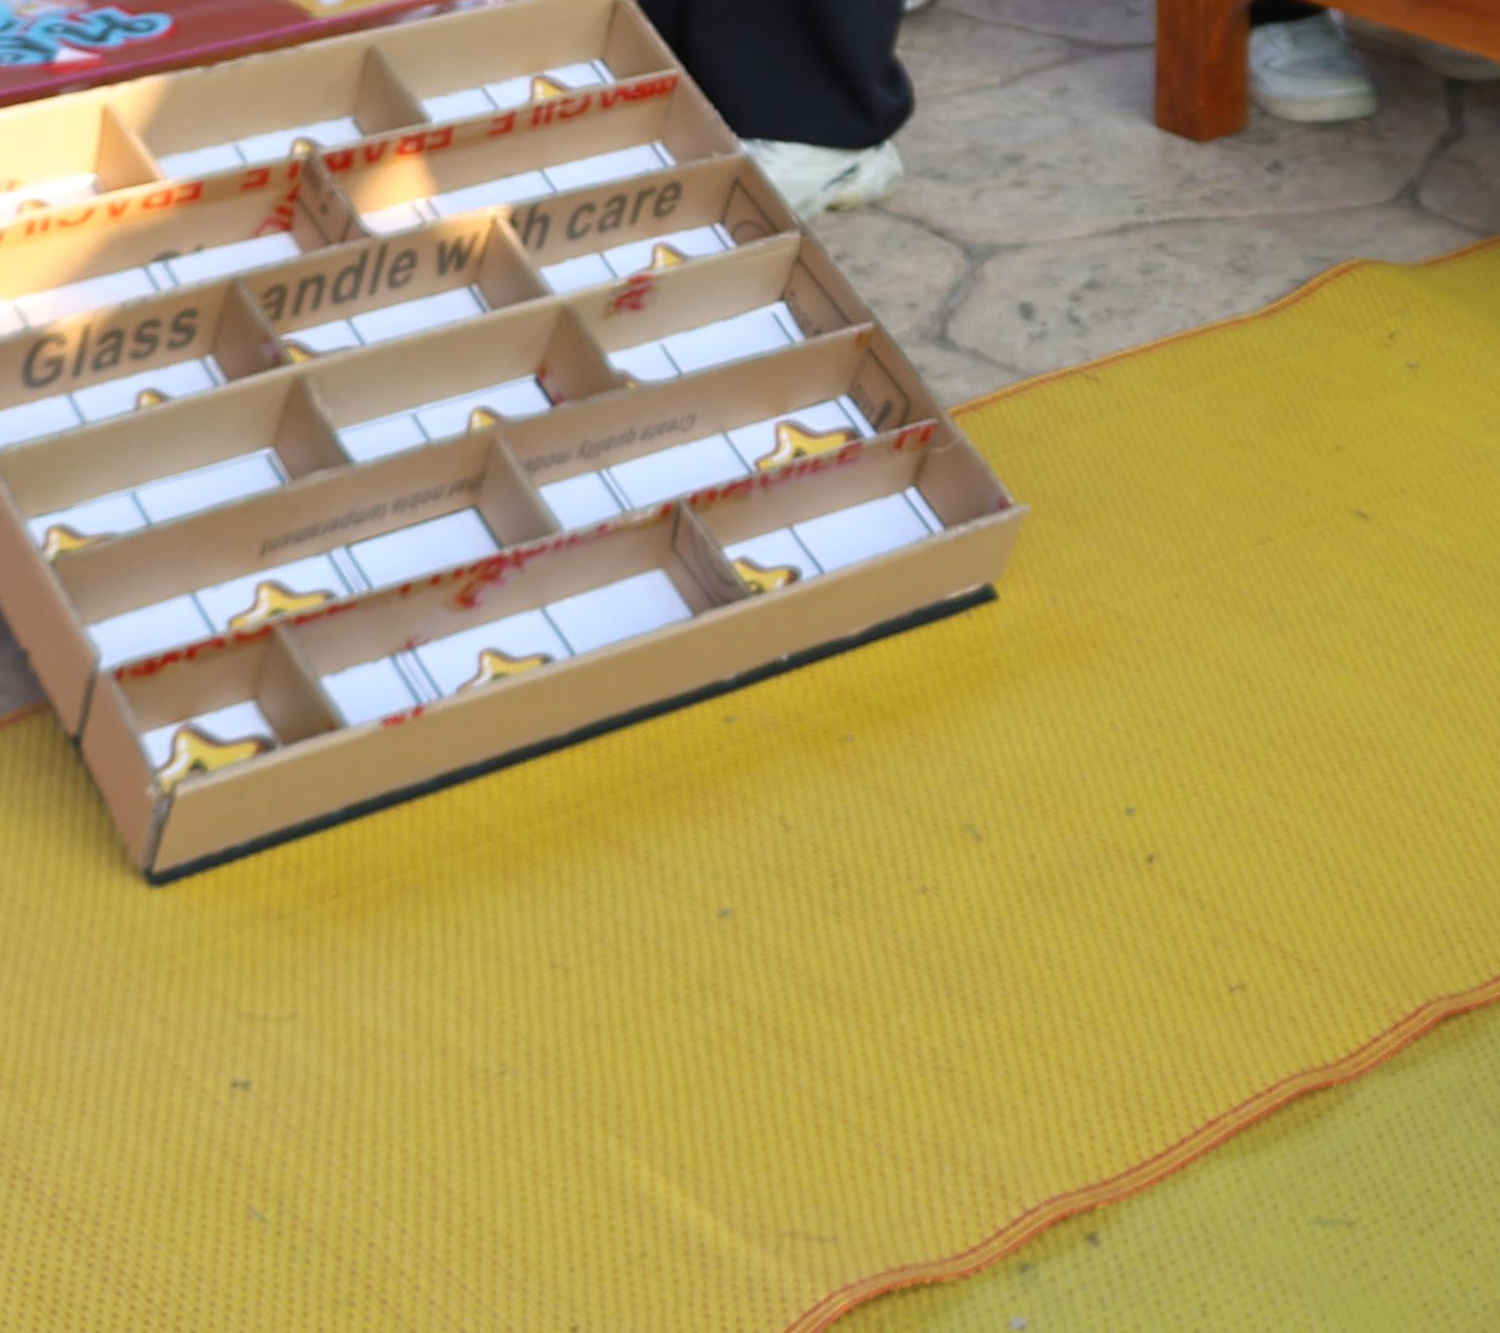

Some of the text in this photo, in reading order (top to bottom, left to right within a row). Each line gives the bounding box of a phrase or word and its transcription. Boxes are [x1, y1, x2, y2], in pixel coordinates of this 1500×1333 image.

[21, 305, 200, 390] Glass
[261, 242, 418, 323] andle
[567, 182, 685, 250] care
